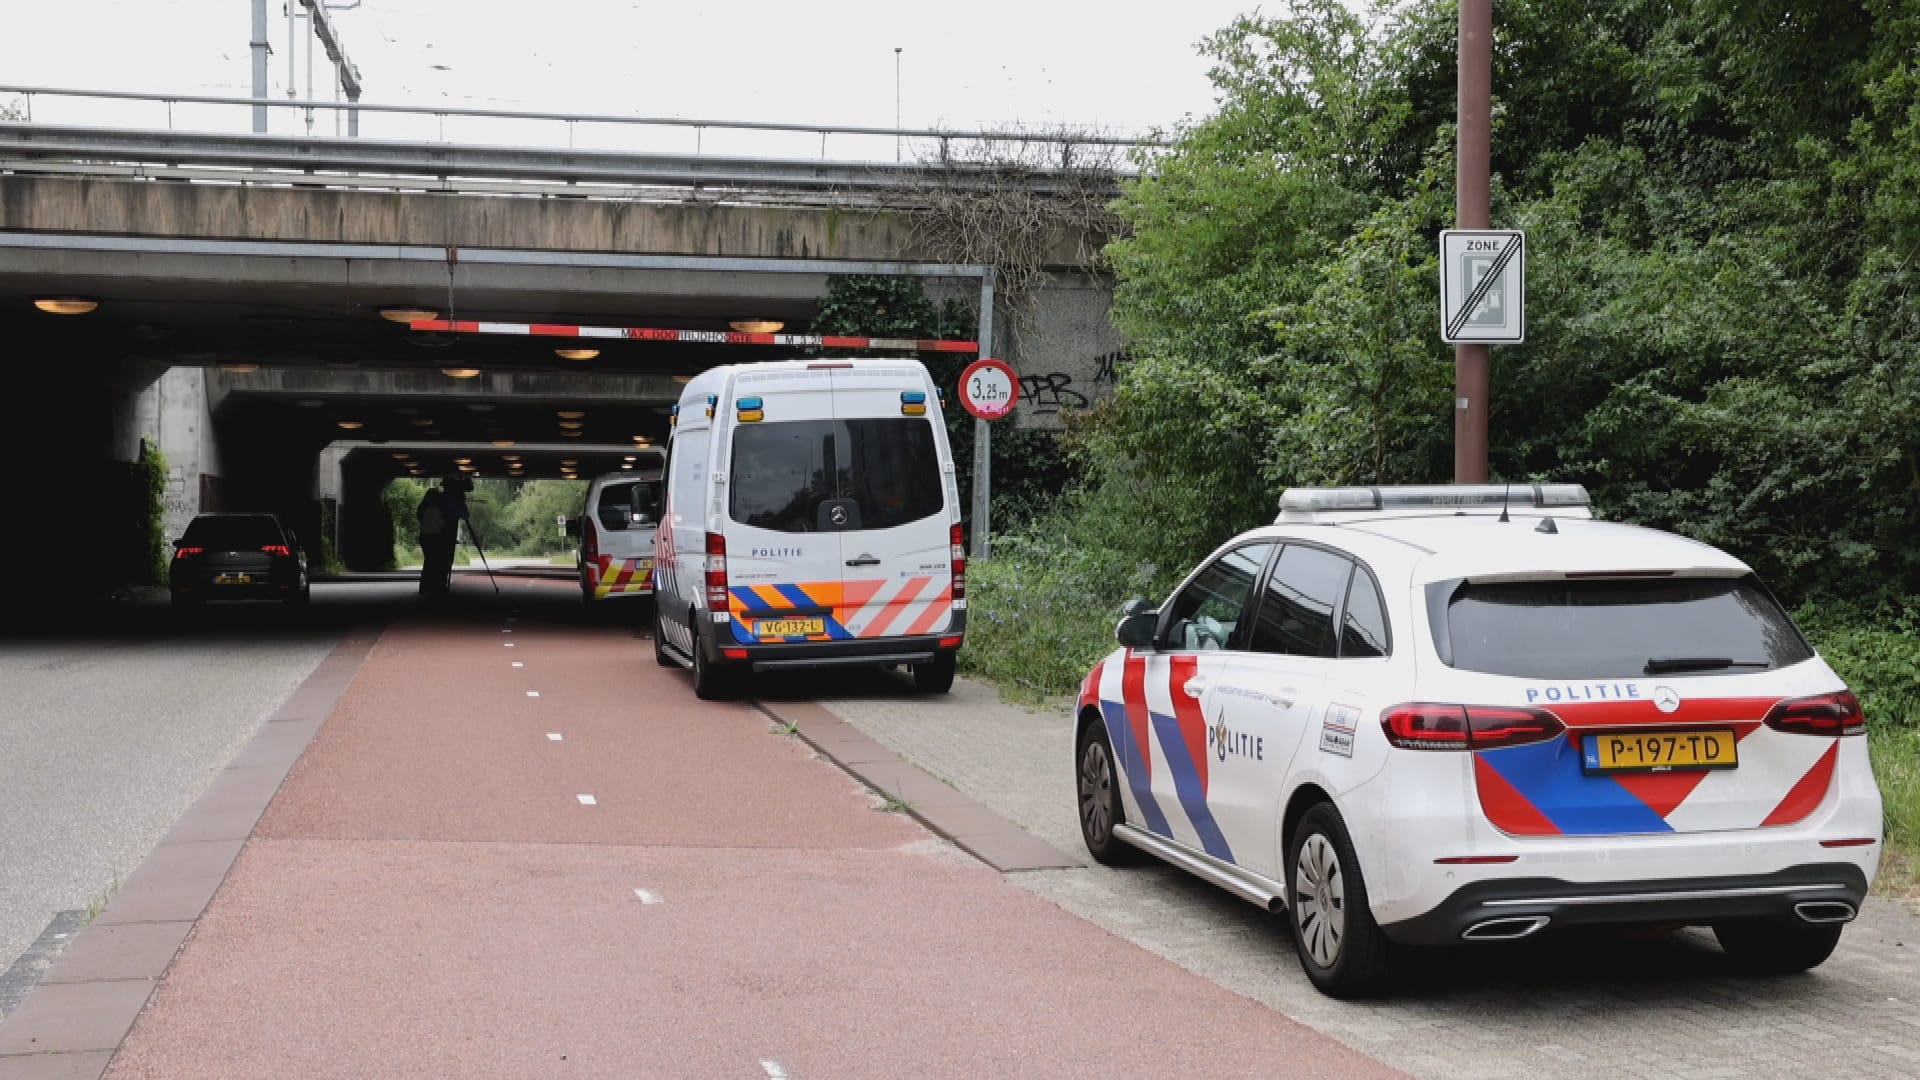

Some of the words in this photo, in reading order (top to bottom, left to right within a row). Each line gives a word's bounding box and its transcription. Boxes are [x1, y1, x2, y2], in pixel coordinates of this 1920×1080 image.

[1466, 239, 1500, 251] ZONE
[785, 335, 794, 345] M
[999, 391, 1008, 399] m
[751, 547, 803, 558] POLITIE
[765, 620, 818, 634] VG-132-L
[1525, 682, 1641, 703] POLITIE
[1209, 725, 1264, 762] POLITIE
[1610, 736, 1720, 764] P-197-TD
